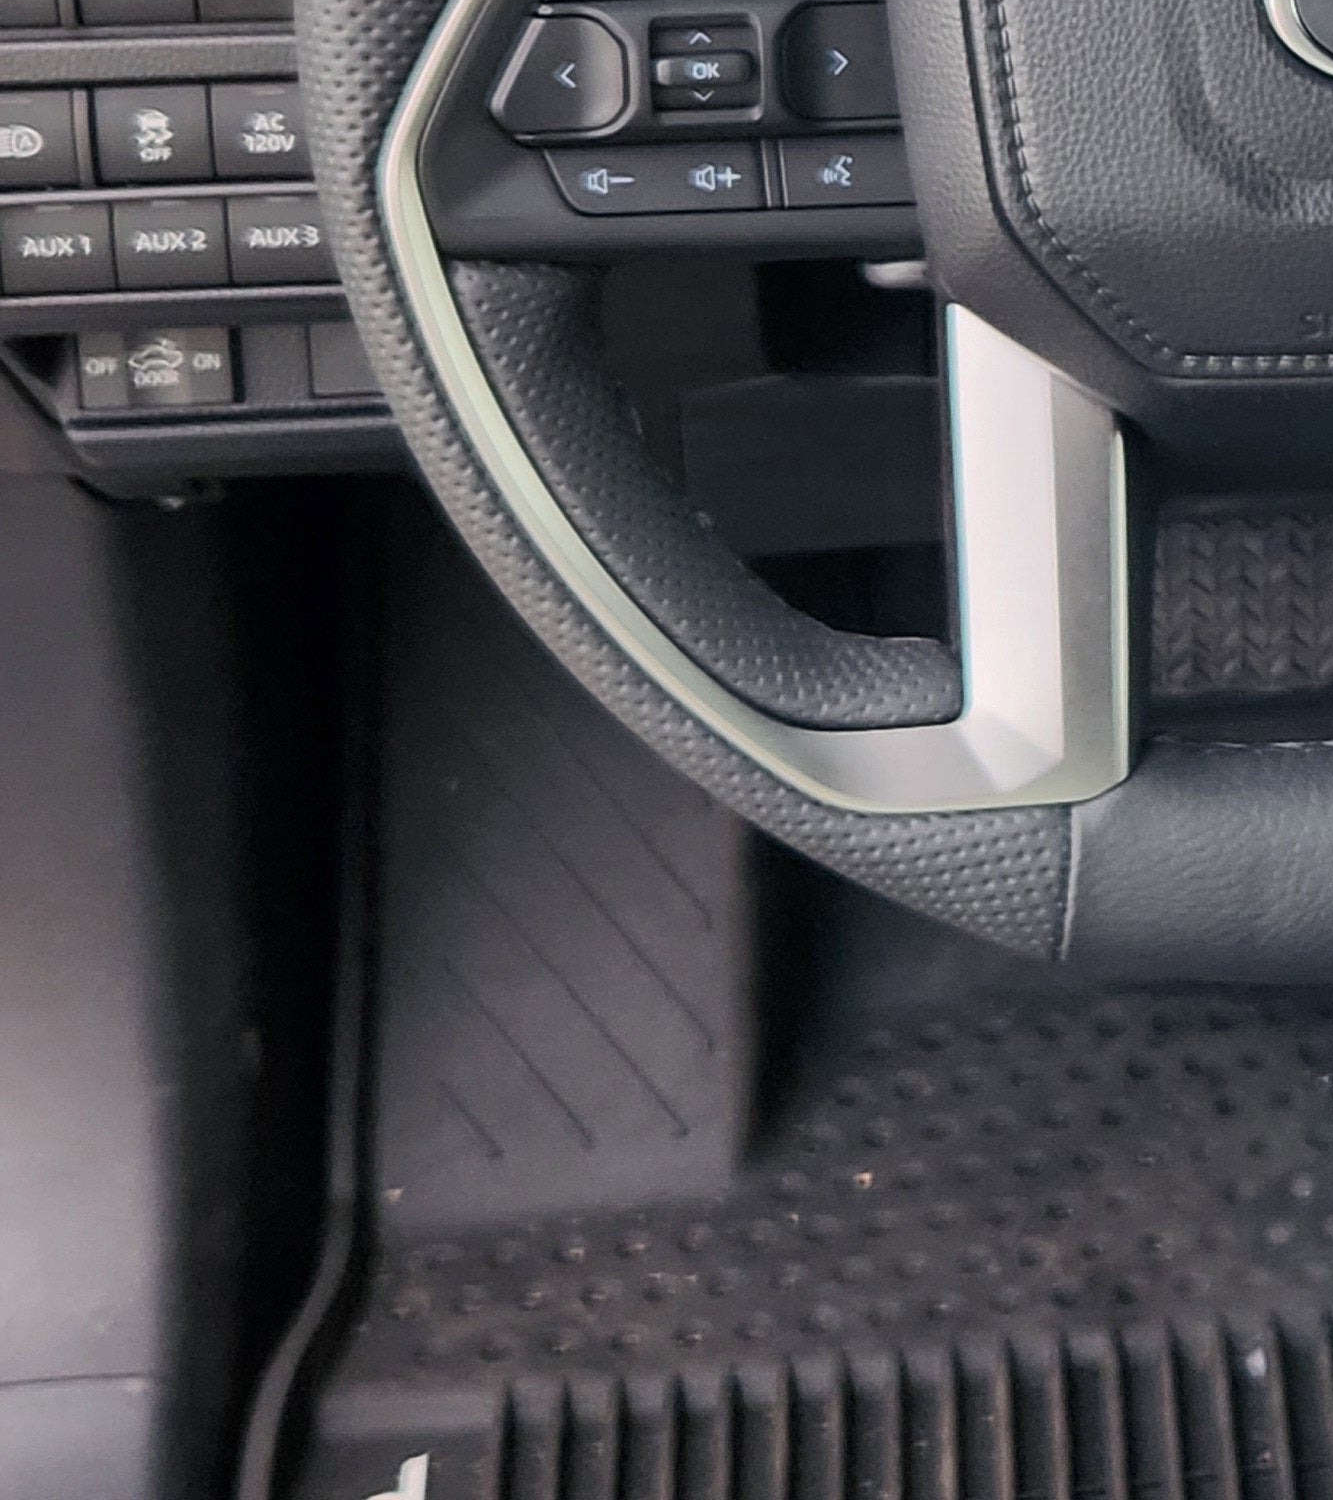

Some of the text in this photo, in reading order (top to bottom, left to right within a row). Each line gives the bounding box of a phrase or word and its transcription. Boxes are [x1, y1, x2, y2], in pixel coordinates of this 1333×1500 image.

[692, 62, 720, 79] OK
[252, 112, 285, 132] AC
[244, 133, 295, 153] 120V
[140, 147, 172, 162] OFF
[22, 236, 91, 257] AUX 1
[135, 230, 207, 253] AUX 2
[248, 226, 320, 249] AUX 3
[193, 353, 221, 370] ON
